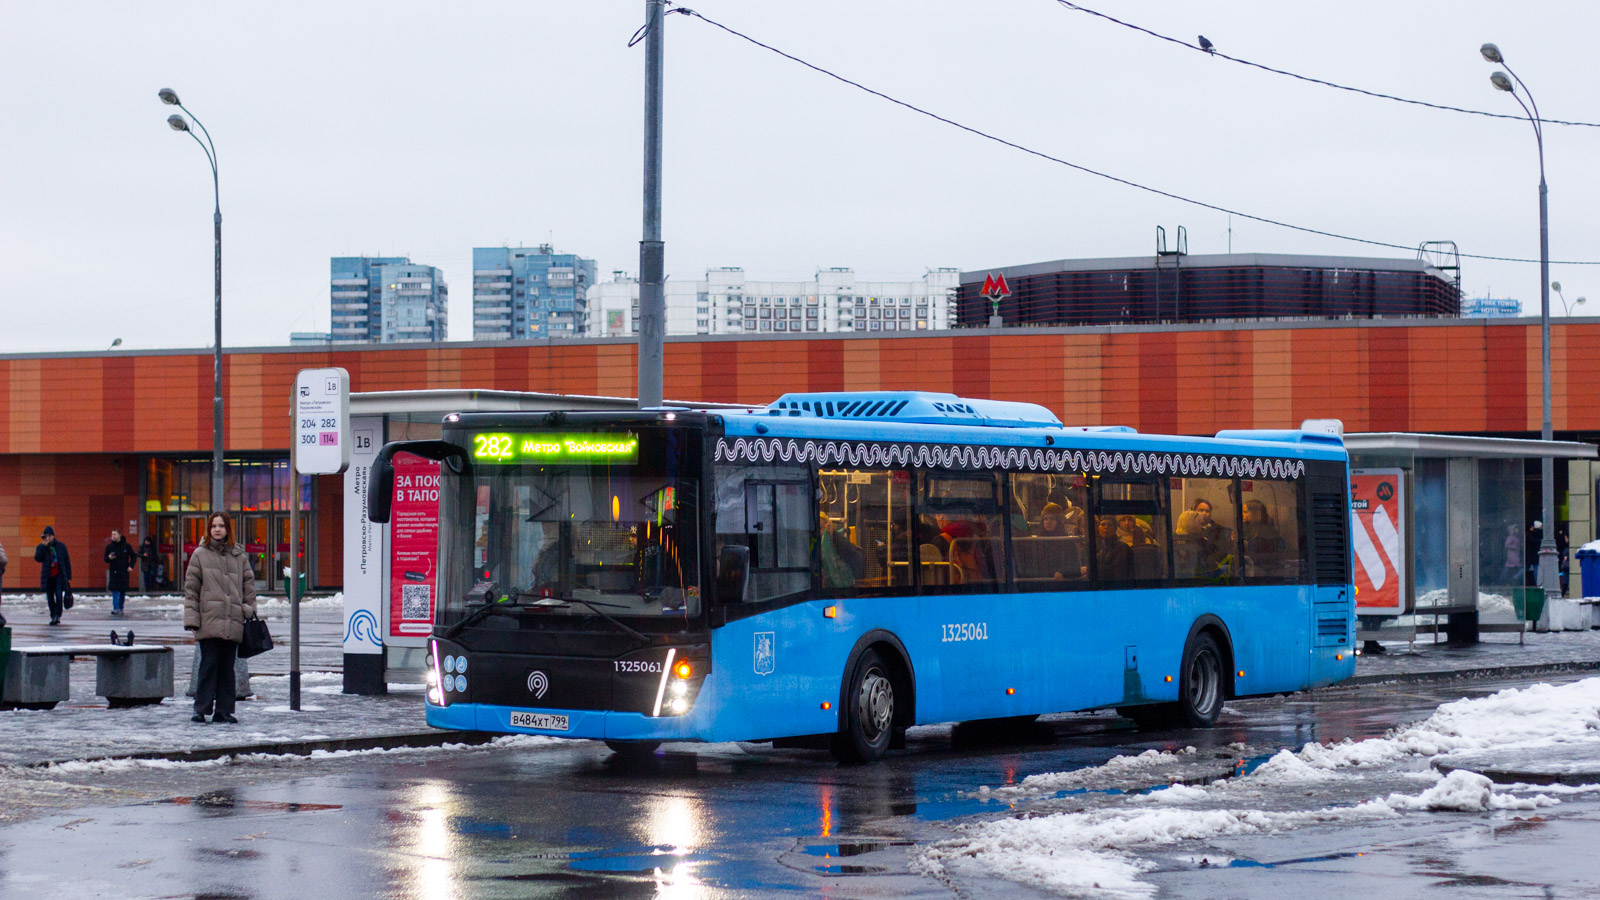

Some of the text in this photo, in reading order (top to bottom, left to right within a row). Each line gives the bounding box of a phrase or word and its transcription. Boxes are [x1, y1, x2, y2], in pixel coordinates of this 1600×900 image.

[301, 418, 336, 429] 204 282
[301, 434, 334, 444] 300 114
[475, 436, 636, 457] 282 Метро "Войковская"
[396, 475, 440, 487] ЗА ПОК
[396, 490, 440, 502] В ТАПО
[942, 622, 989, 643] 1325061
[614, 660, 663, 673] 1325061
[551, 715, 567, 726] 799
